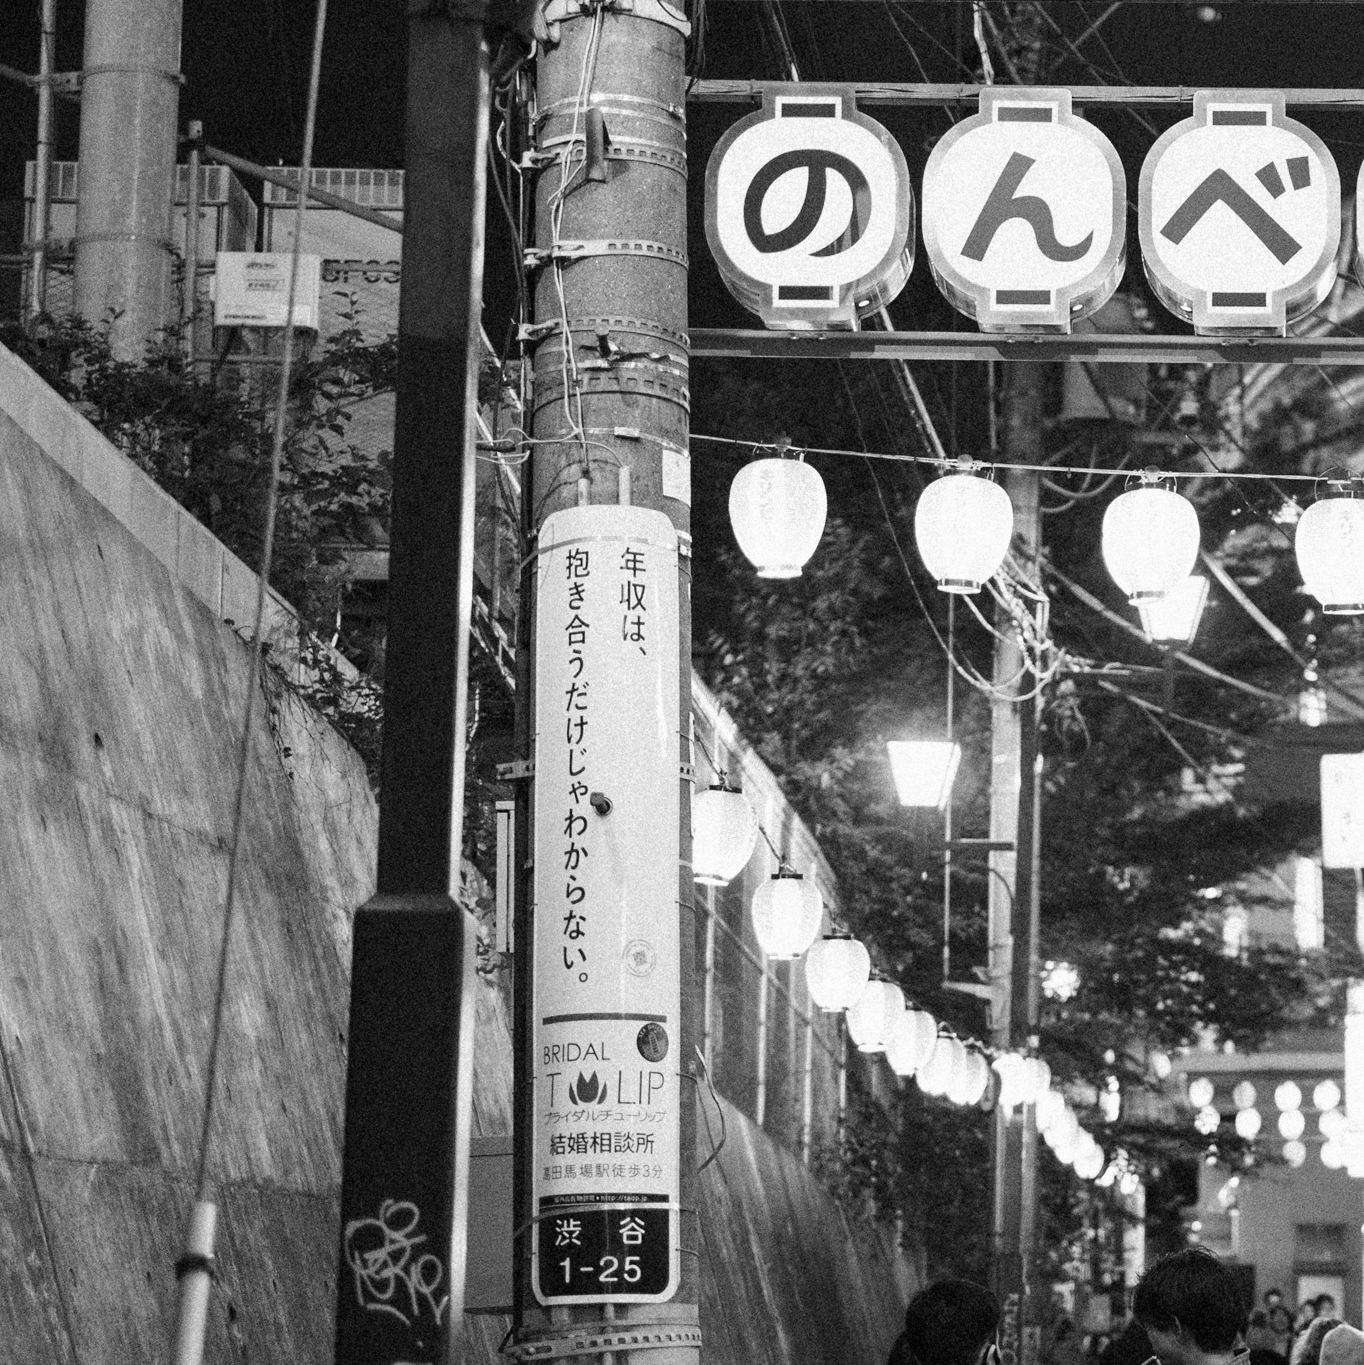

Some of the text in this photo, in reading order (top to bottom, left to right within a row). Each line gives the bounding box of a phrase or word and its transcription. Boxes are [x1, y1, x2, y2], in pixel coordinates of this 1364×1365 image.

[619, 547, 648, 656] 年収は、
[562, 547, 590, 983] 抱き合うだけじゃわからない。
[543, 1041, 611, 1066] BRIDAL
[543, 1109, 667, 1126] ブライダルチューリップ
[549, 1131, 656, 1157] 結婚相談所
[554, 1216, 646, 1247] 渋谷
[558, 1255, 642, 1285] 1-25
